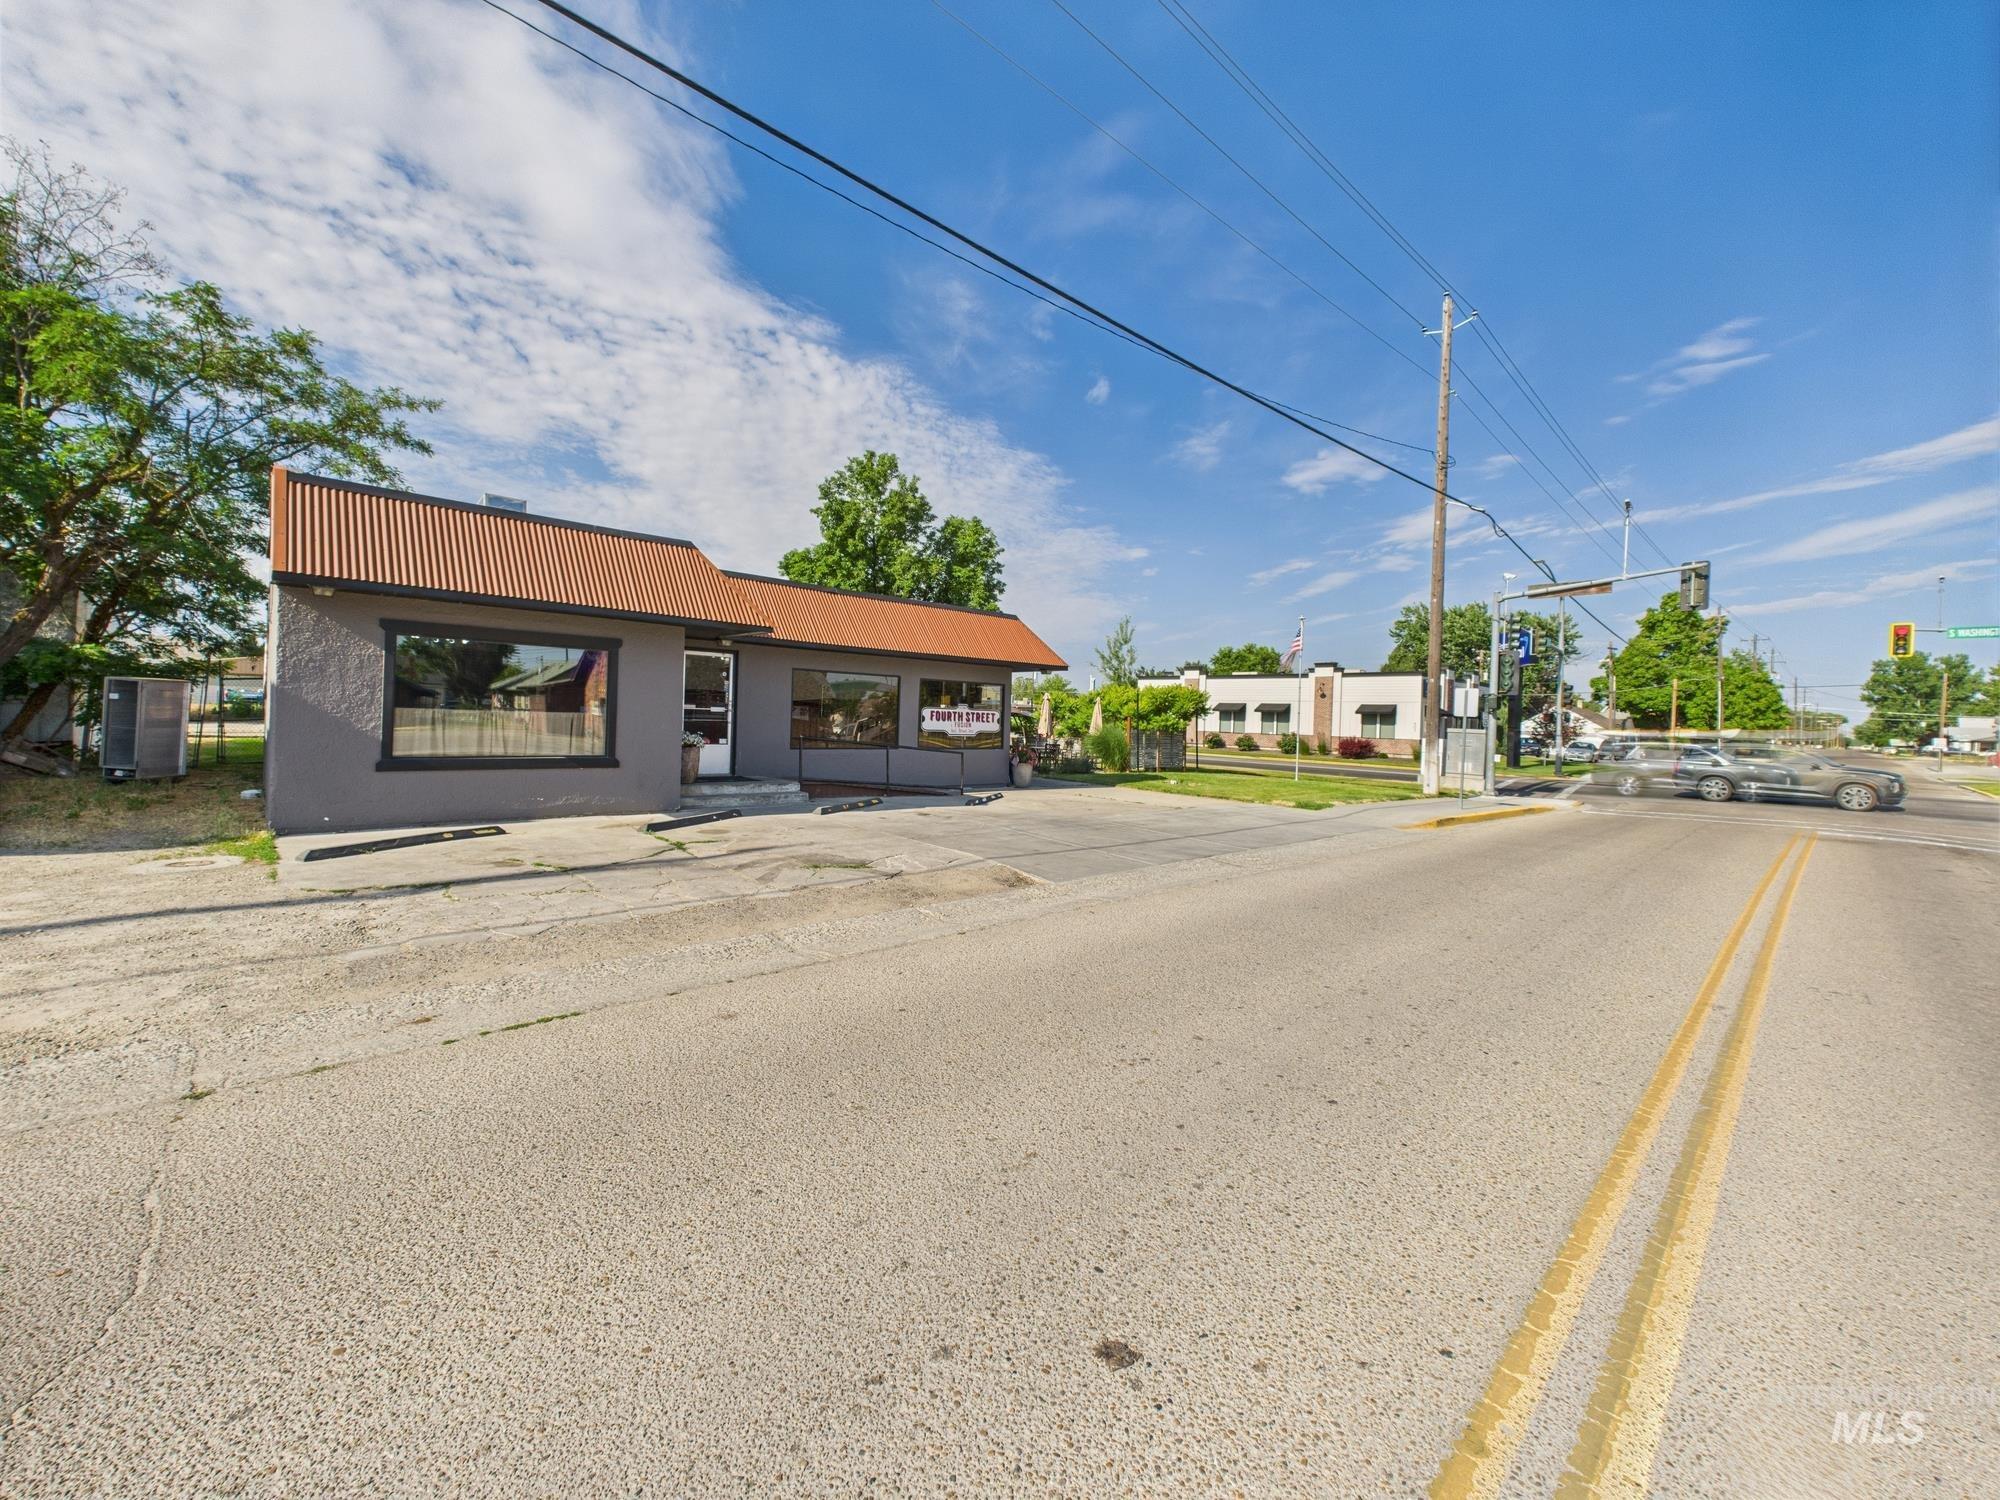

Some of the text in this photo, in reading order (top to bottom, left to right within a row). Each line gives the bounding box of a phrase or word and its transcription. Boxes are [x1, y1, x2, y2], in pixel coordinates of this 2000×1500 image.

[1948, 629, 1956, 638] S
[930, 710, 996, 723] FOURTH STREET
